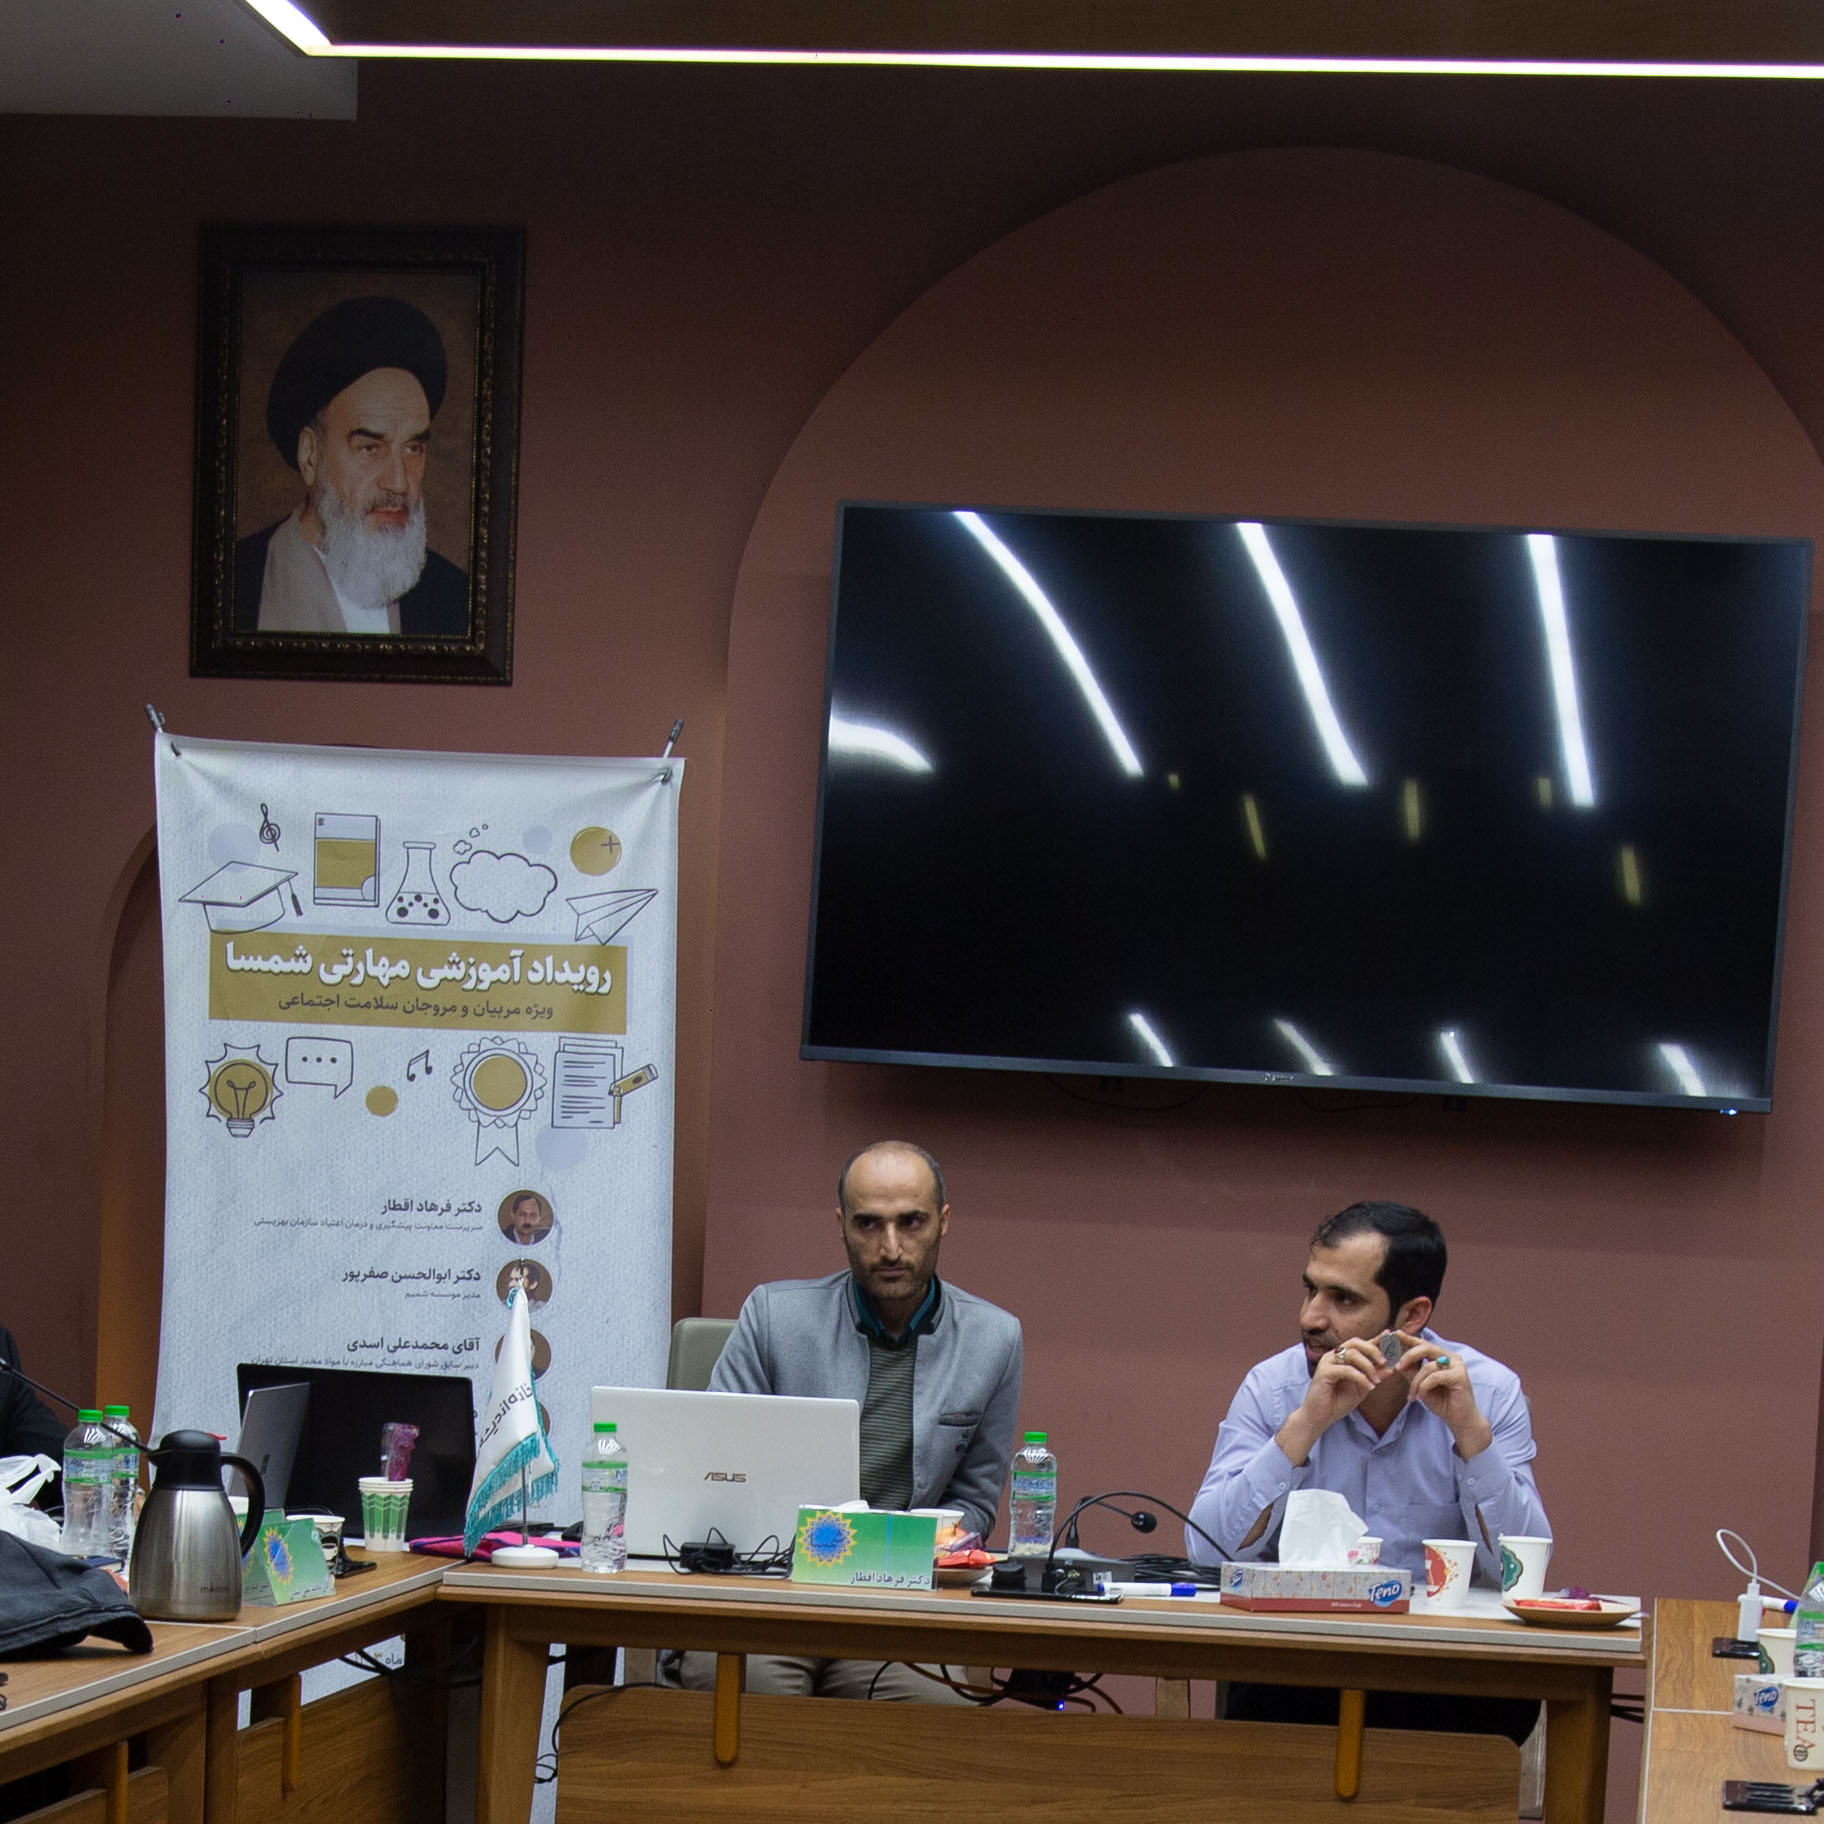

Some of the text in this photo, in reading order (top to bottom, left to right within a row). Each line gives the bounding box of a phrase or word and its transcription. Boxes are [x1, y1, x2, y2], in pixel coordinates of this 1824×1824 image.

[225, 940, 612, 995] رویداد آموزشی مهارتی شمسا
[278, 992, 554, 1020] ویژه مربیان و مروجان سلامت اجتماعی
[416, 1197, 452, 1217] فرهاد
[454, 1200, 483, 1217] دکتر
[253, 1216, 288, 1229] بهزیستی
[289, 1217, 319, 1229] سازمان
[320, 1217, 344, 1229] اعتیاد
[345, 1219, 369, 1231] درمان
[375, 1219, 412, 1232] پیشگیری
[342, 1266, 481, 1284] دکتر ابوالحسن صفرپور
[346, 1336, 480, 1354] آقای محمدعلی اسدی
[350, 1357, 374, 1368] مبارزه
[375, 1357, 413, 1368] هماهنگی
[703, 1471, 747, 1483] ASUS
[907, 1574, 931, 1588] دکتر
[1369, 1582, 1401, 1603] Teno
[384, 1652, 403, 1665] ماه
[1796, 1698, 1816, 1750] TEA
